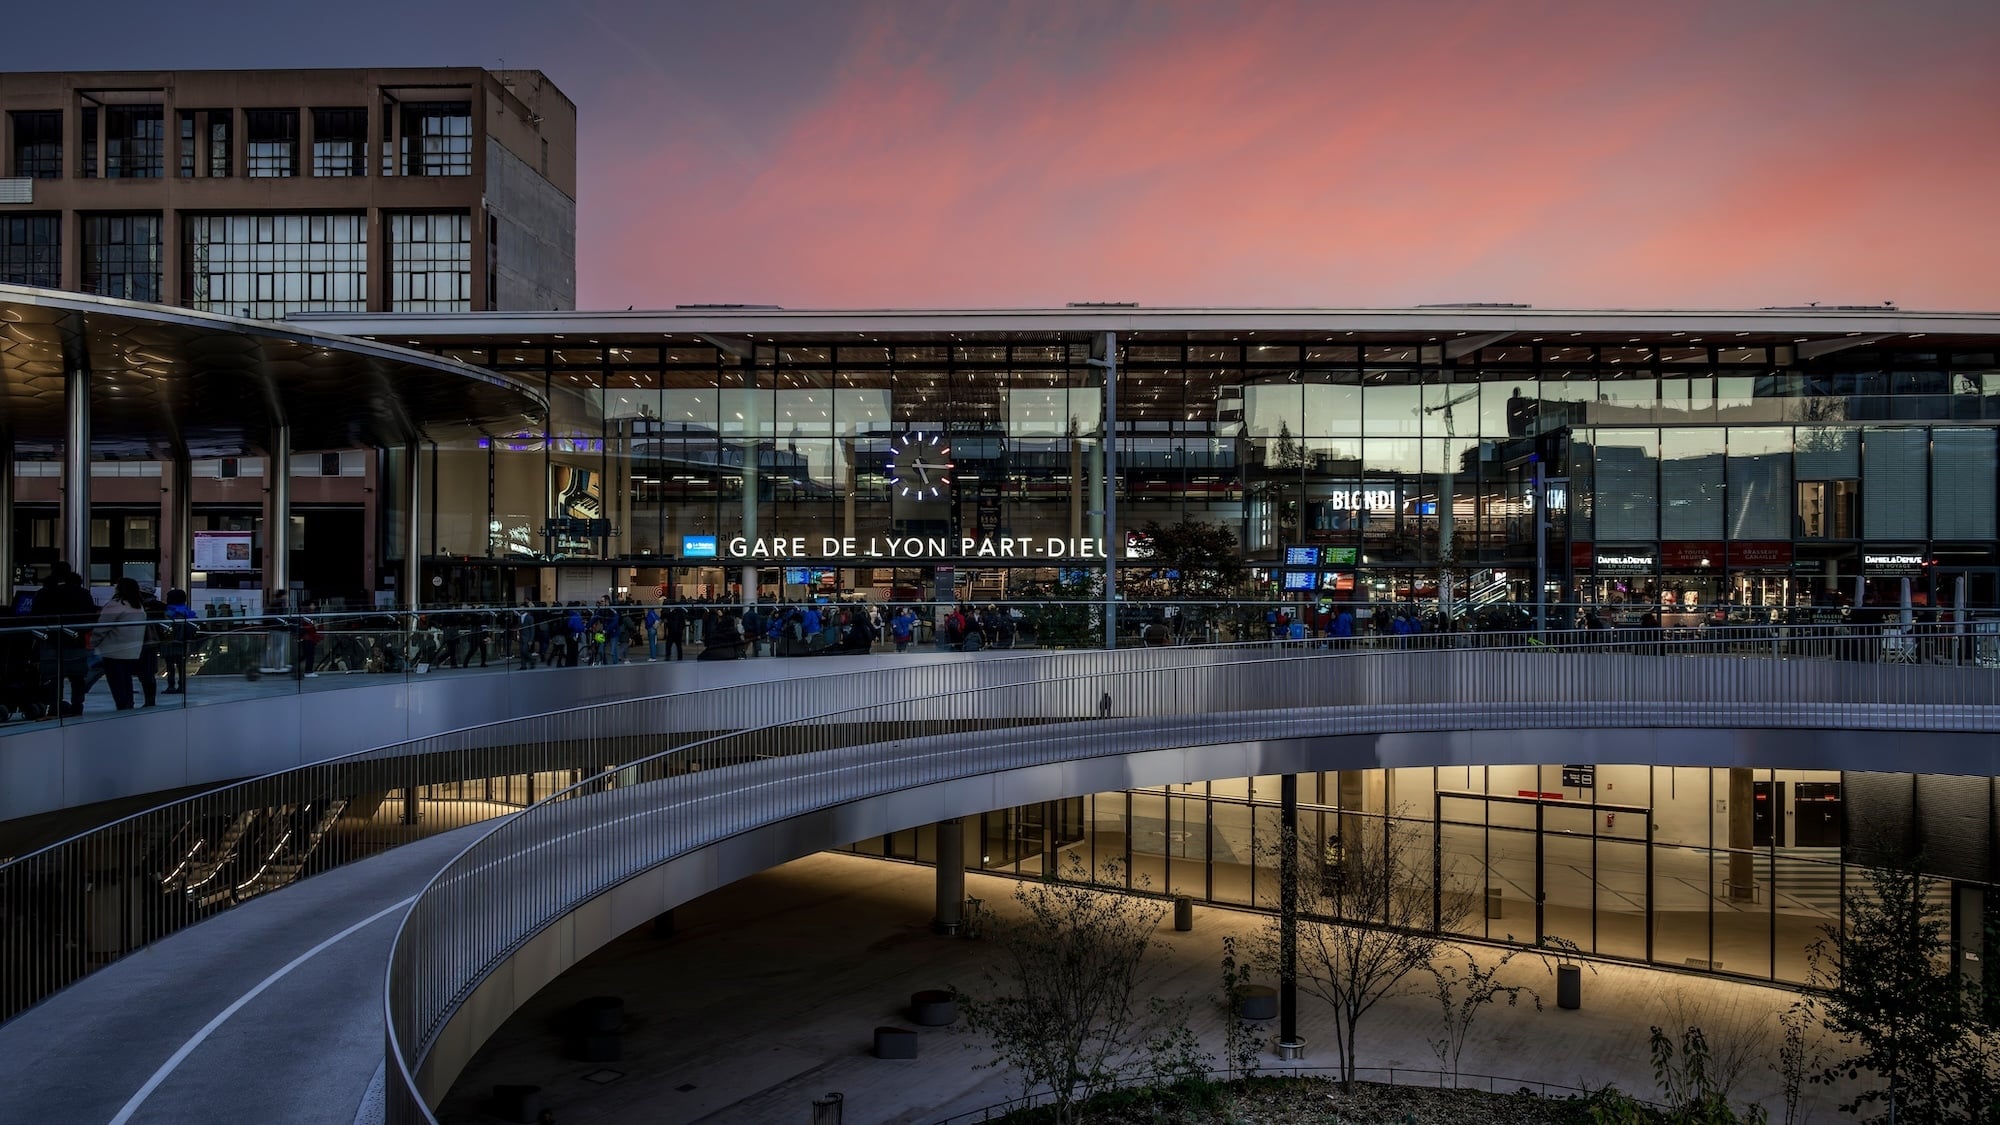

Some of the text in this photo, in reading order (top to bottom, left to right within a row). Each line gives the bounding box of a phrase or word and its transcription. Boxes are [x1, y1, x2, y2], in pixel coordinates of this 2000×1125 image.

[729, 537, 807, 557] GARE
[822, 537, 857, 557] DE
[870, 537, 947, 557] LYON
